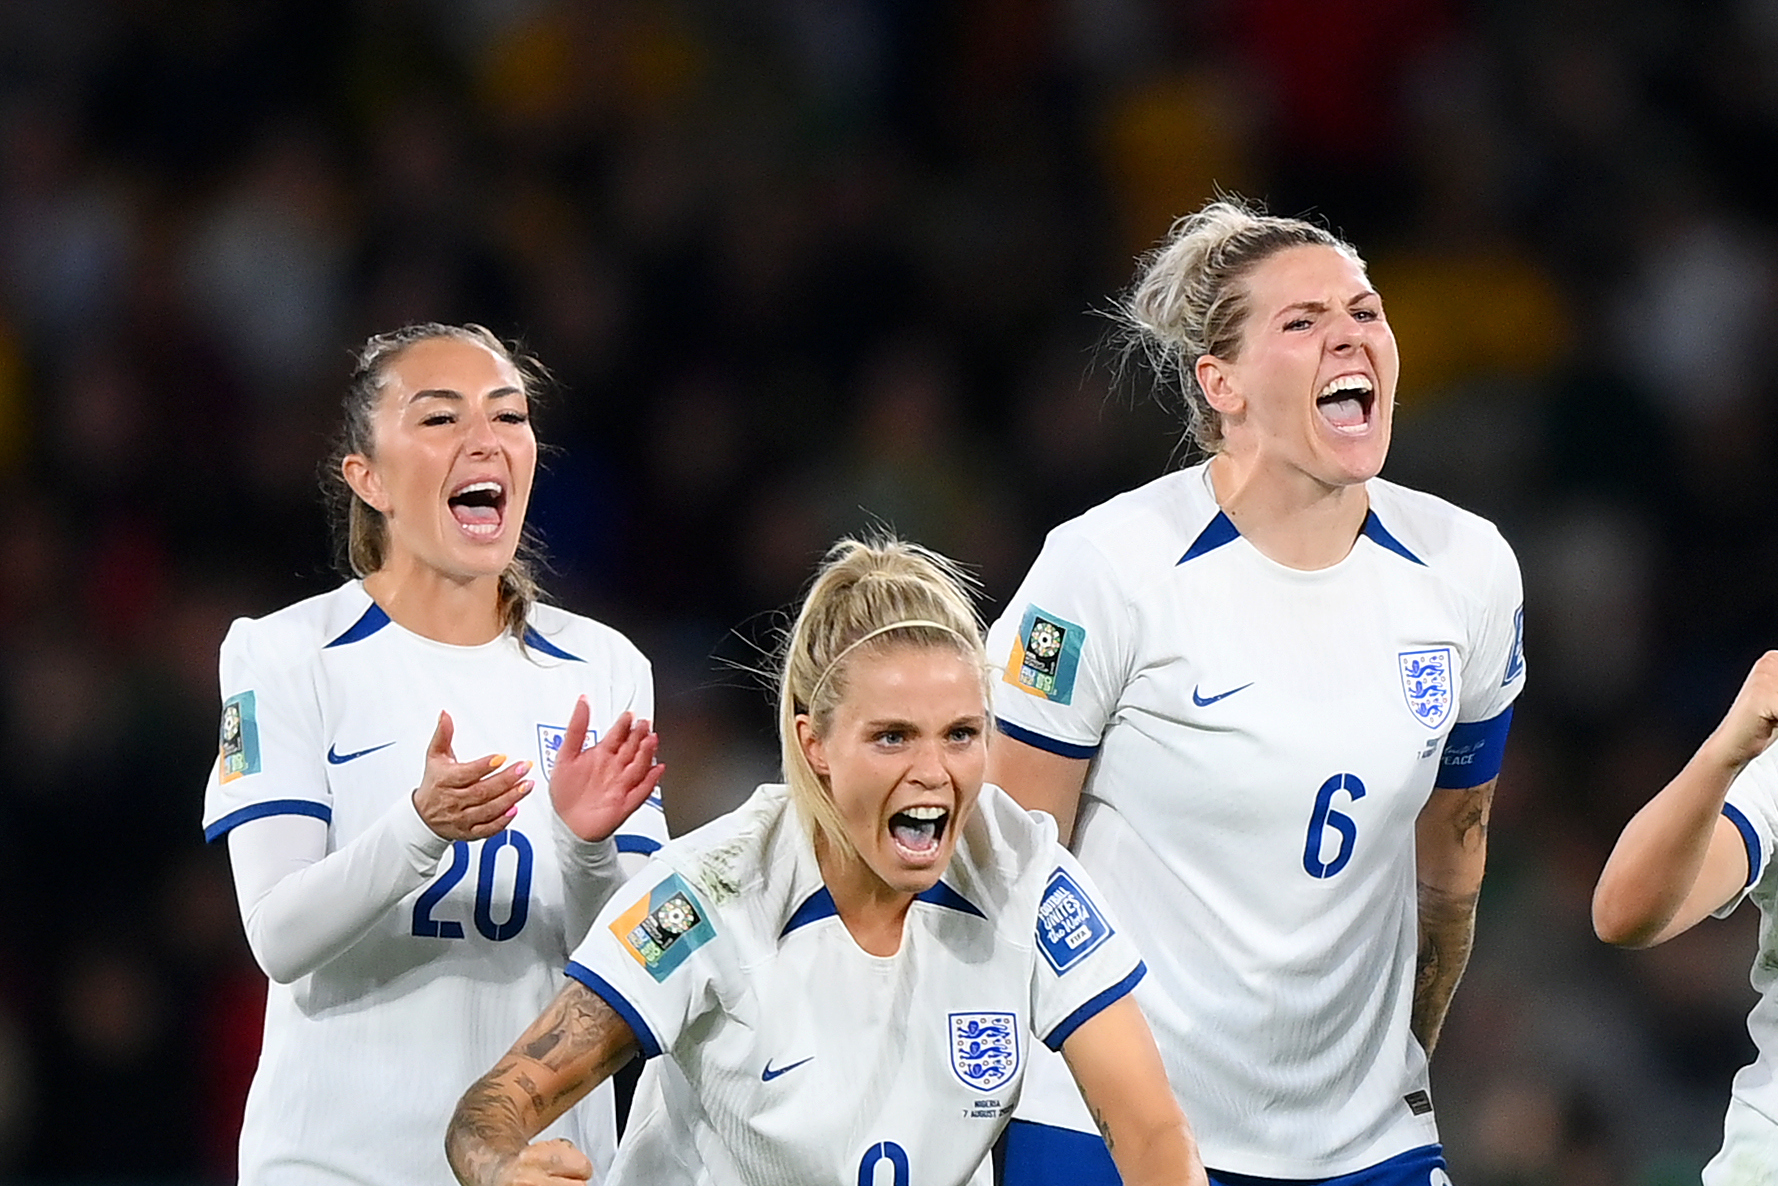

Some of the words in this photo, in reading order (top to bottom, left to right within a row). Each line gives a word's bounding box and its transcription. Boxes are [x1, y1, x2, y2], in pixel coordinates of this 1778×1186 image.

[1441, 753, 1476, 766] EACE
[1303, 773, 1366, 879] 6
[412, 829, 533, 941] 20
[1044, 894, 1080, 930] UNITES
[1047, 927, 1065, 944] the
[1061, 904, 1090, 933] World
[1070, 930, 1087, 944] FIFA
